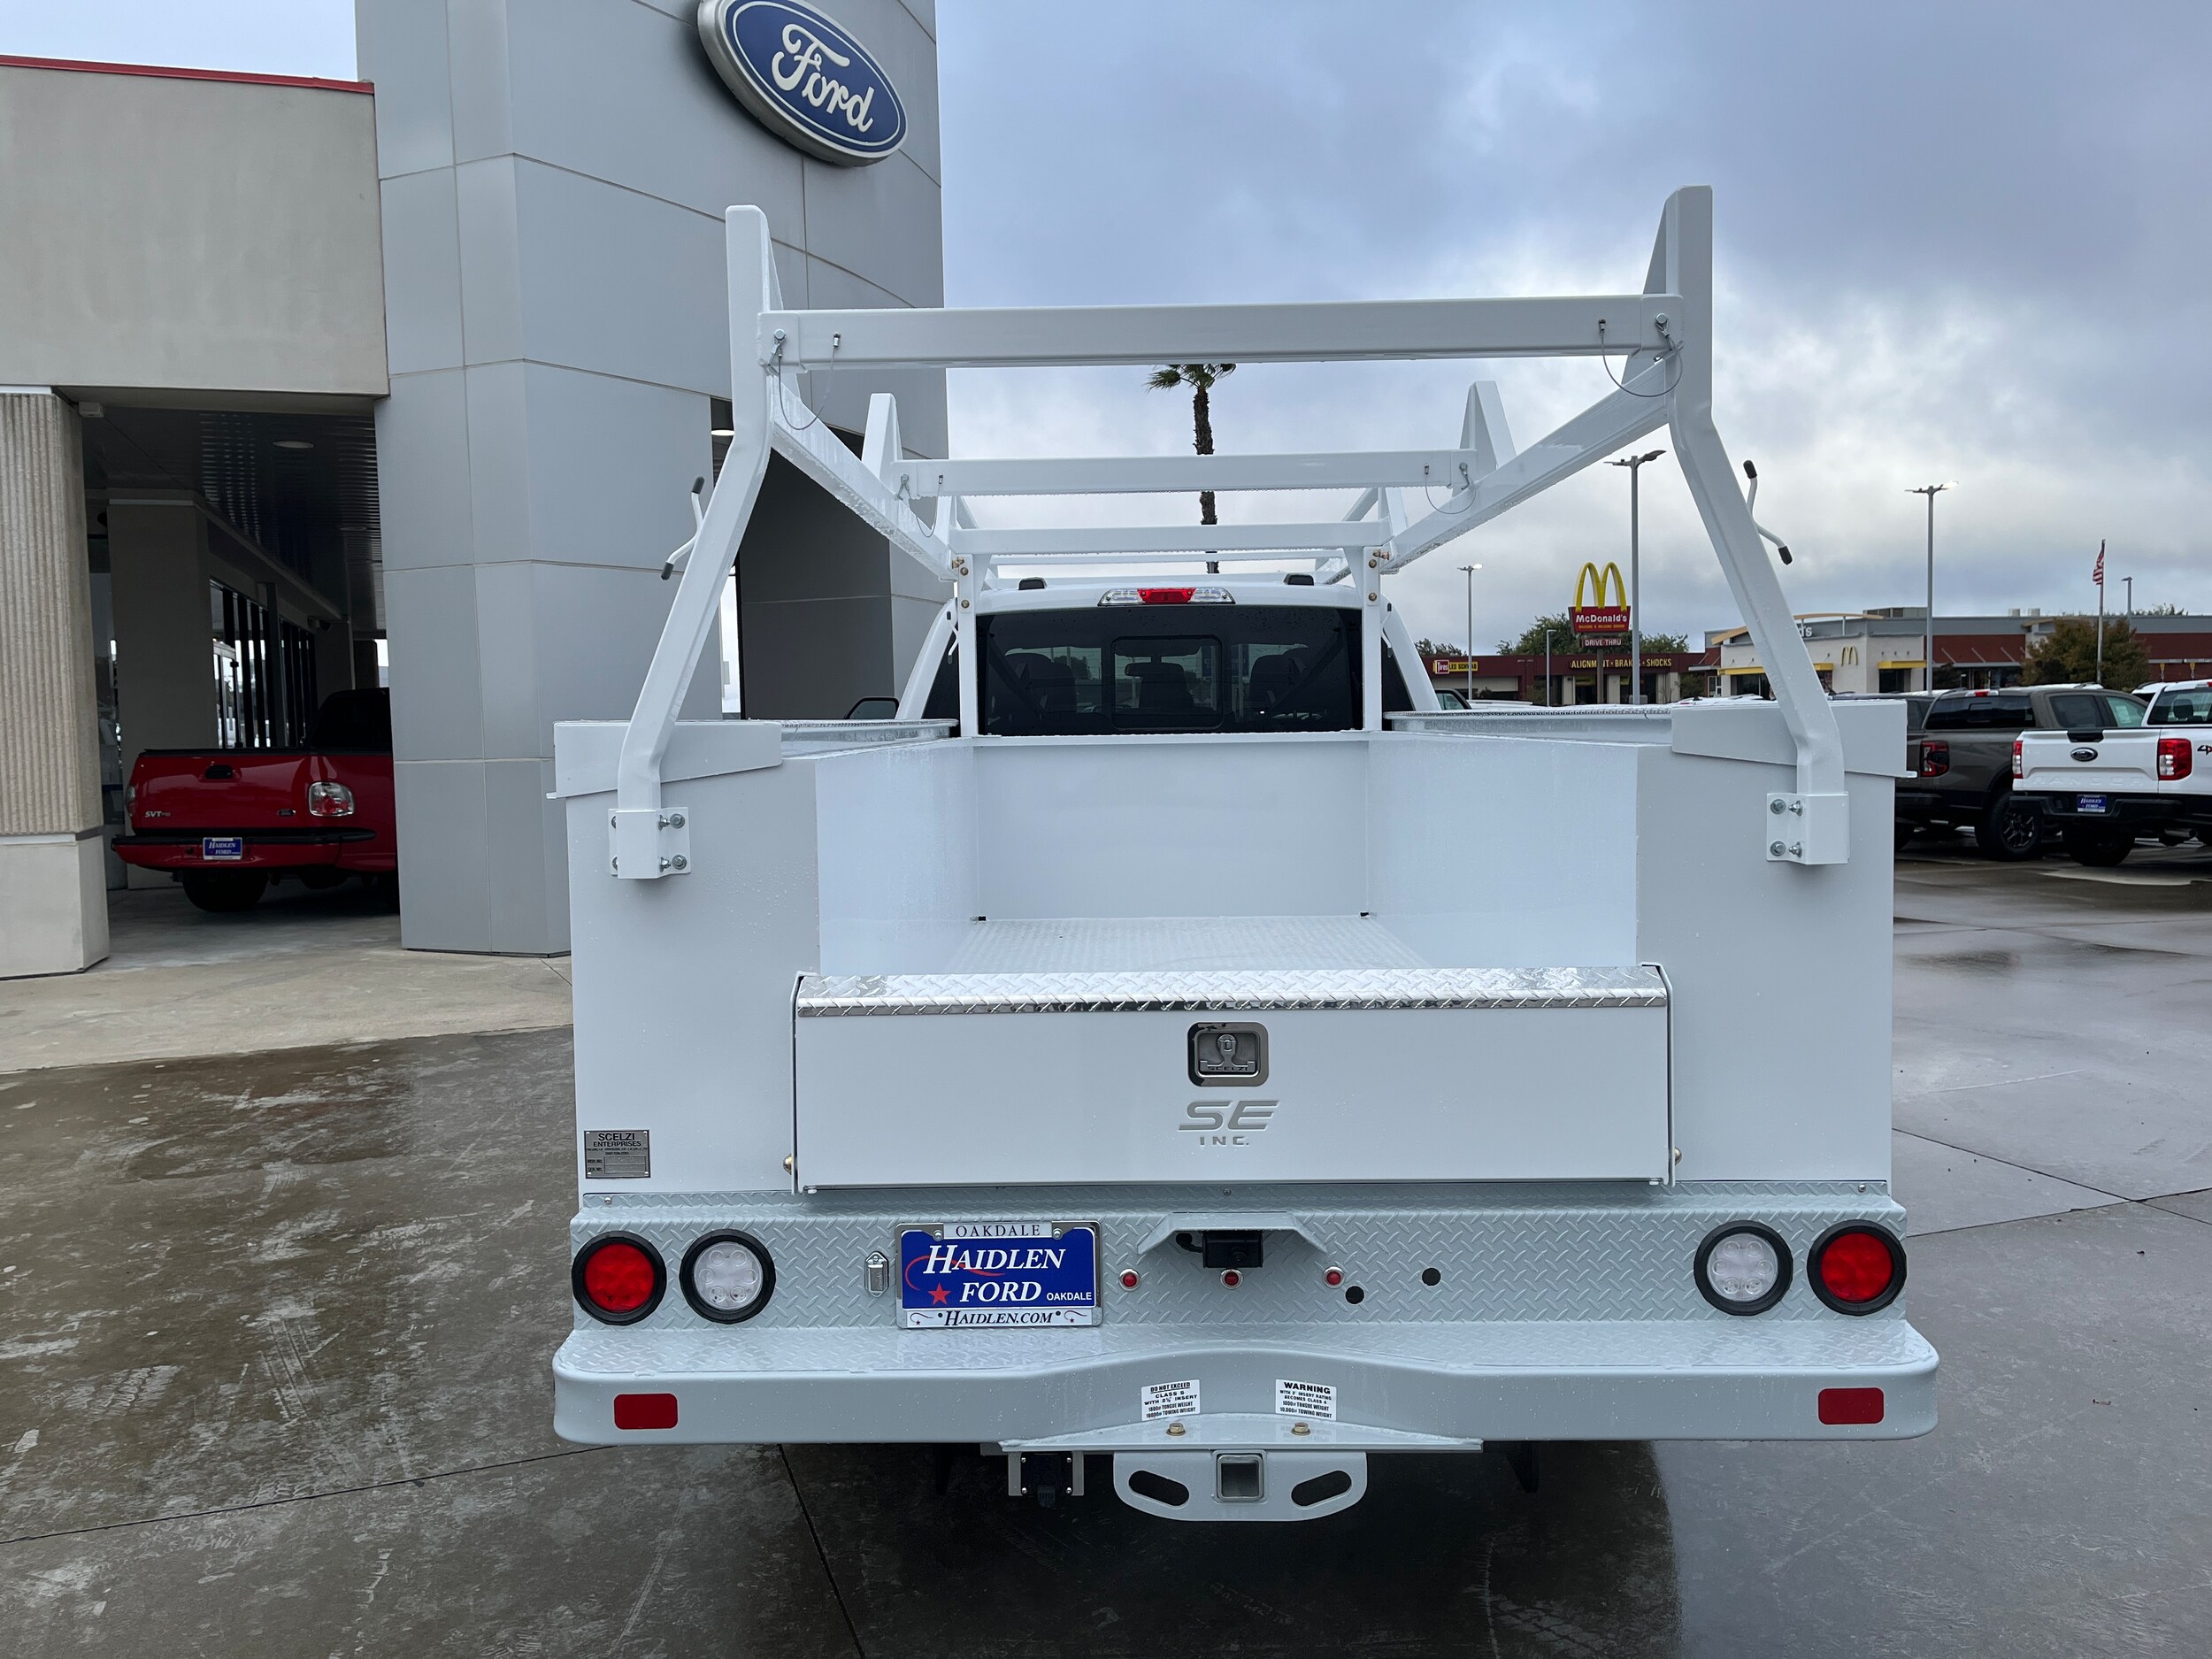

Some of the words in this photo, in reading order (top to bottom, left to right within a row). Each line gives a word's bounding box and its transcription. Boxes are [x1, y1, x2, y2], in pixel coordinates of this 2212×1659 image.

[772, 23, 875, 133] Ford
[1575, 614, 1627, 623] McDonald's
[1571, 659, 1609, 669] ALIGNMNT
[1615, 658, 1641, 668] BRAK
[1647, 658, 1672, 667] SHOCKS
[1179, 1101, 1279, 1132] SE
[1200, 1136, 1249, 1146] INC.
[956, 1225, 1041, 1238] OAKDALE
[923, 1244, 1066, 1274] HAIDLEN
[959, 1281, 1042, 1302] FORD
[1046, 1292, 1093, 1302] OAKDALE
[944, 1310, 1054, 1326] HAIDLEN.COM
[1284, 1382, 1331, 1394] WARNING
